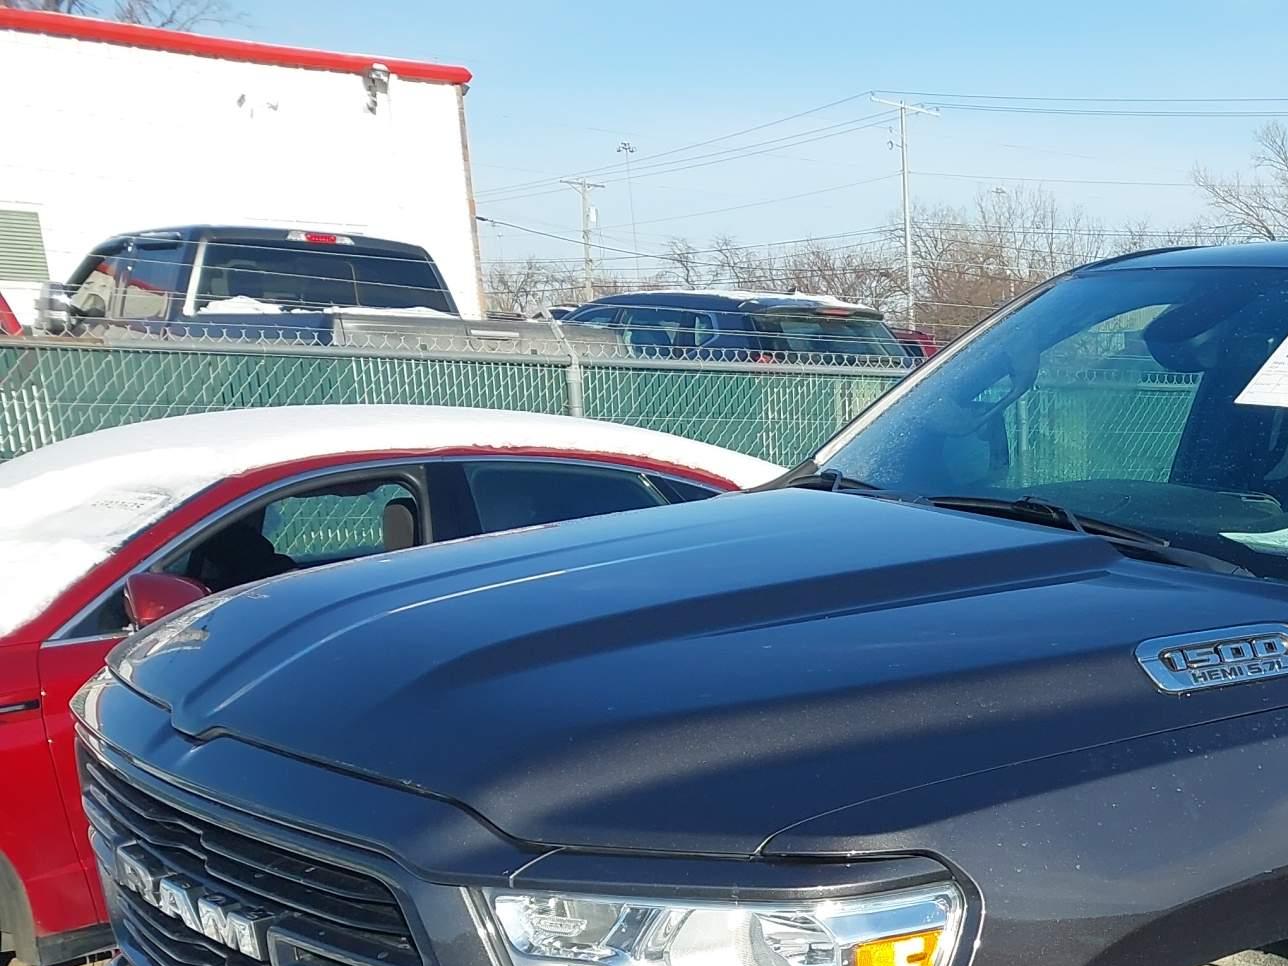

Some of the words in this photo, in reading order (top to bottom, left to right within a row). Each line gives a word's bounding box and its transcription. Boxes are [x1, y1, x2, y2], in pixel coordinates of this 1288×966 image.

[1163, 636, 1286, 672] 1500
[1191, 665, 1244, 685] HEMI
[116, 841, 268, 962] RAM
